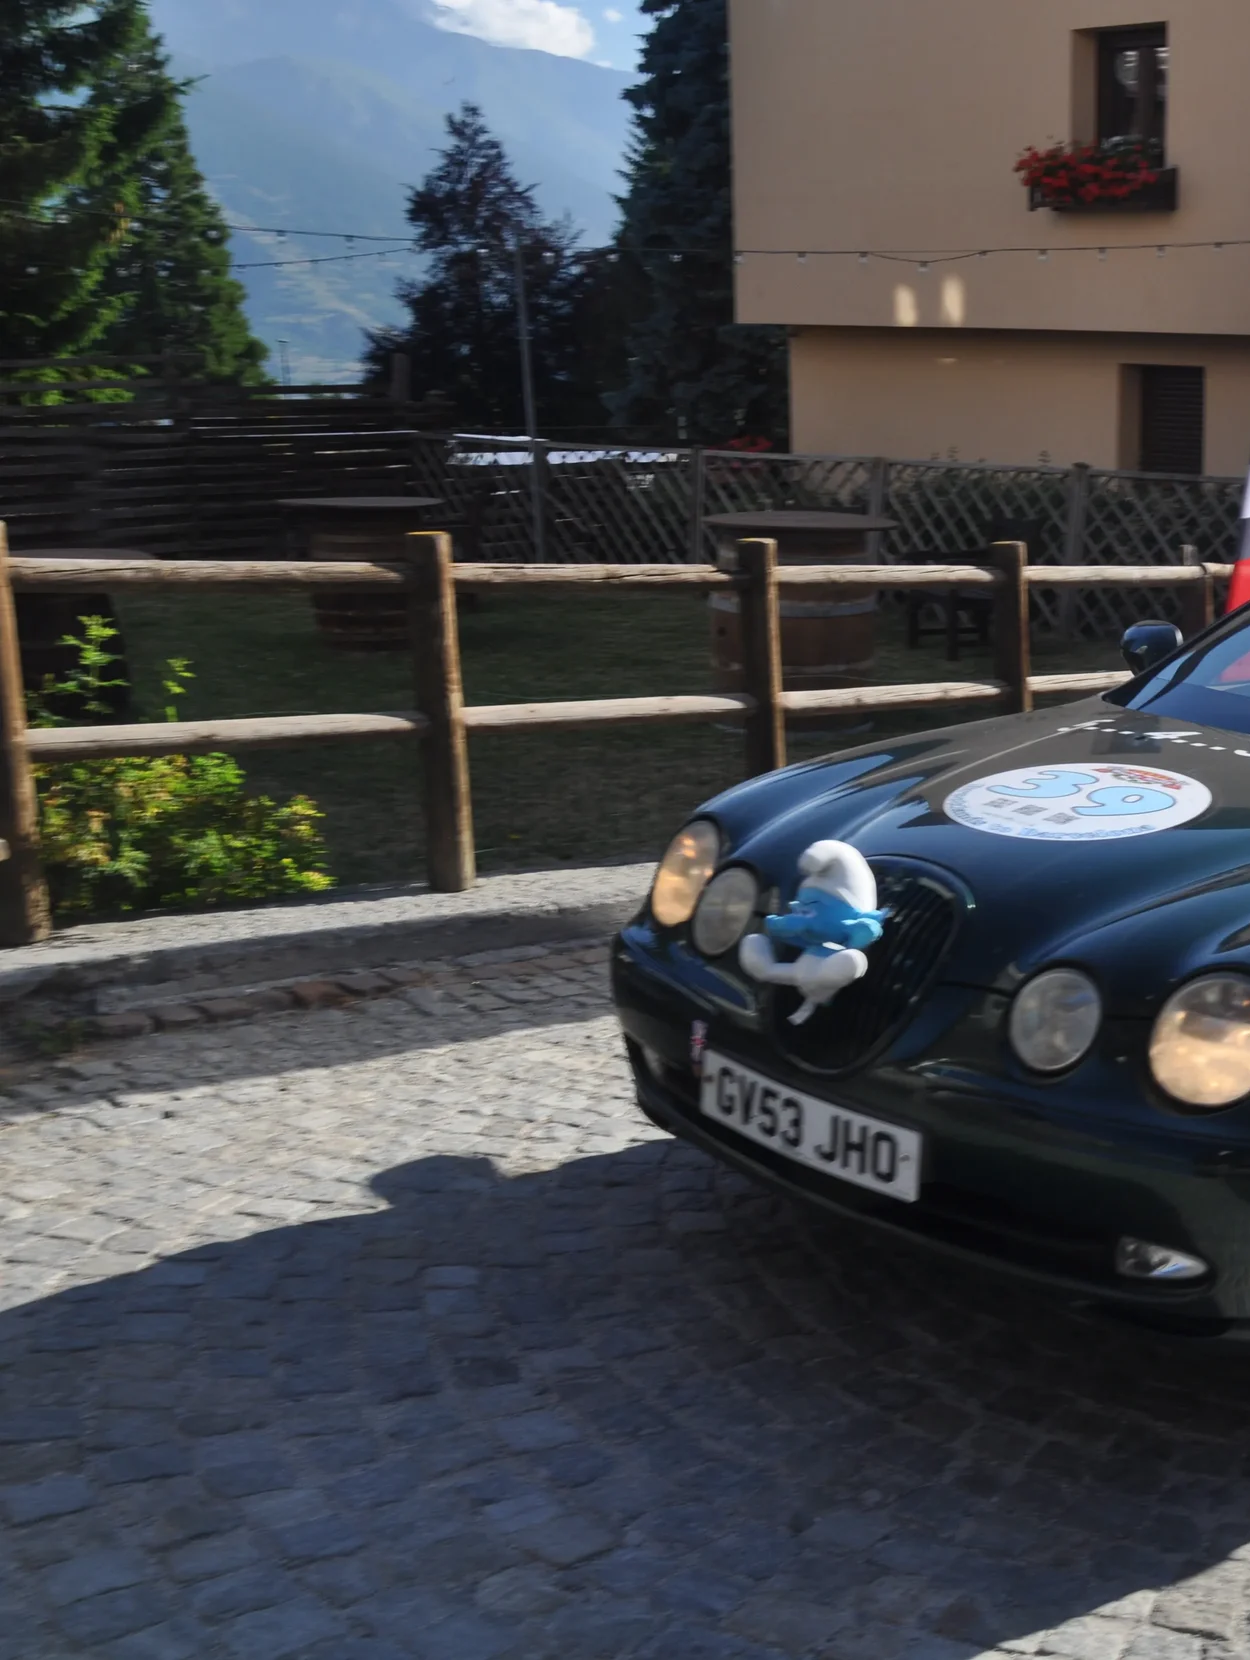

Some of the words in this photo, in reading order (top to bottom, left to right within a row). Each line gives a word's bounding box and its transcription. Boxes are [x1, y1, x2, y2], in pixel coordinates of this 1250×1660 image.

[987, 769, 1177, 817] 39
[716, 1065, 805, 1149] GV53
[814, 1114, 899, 1184] JHO
